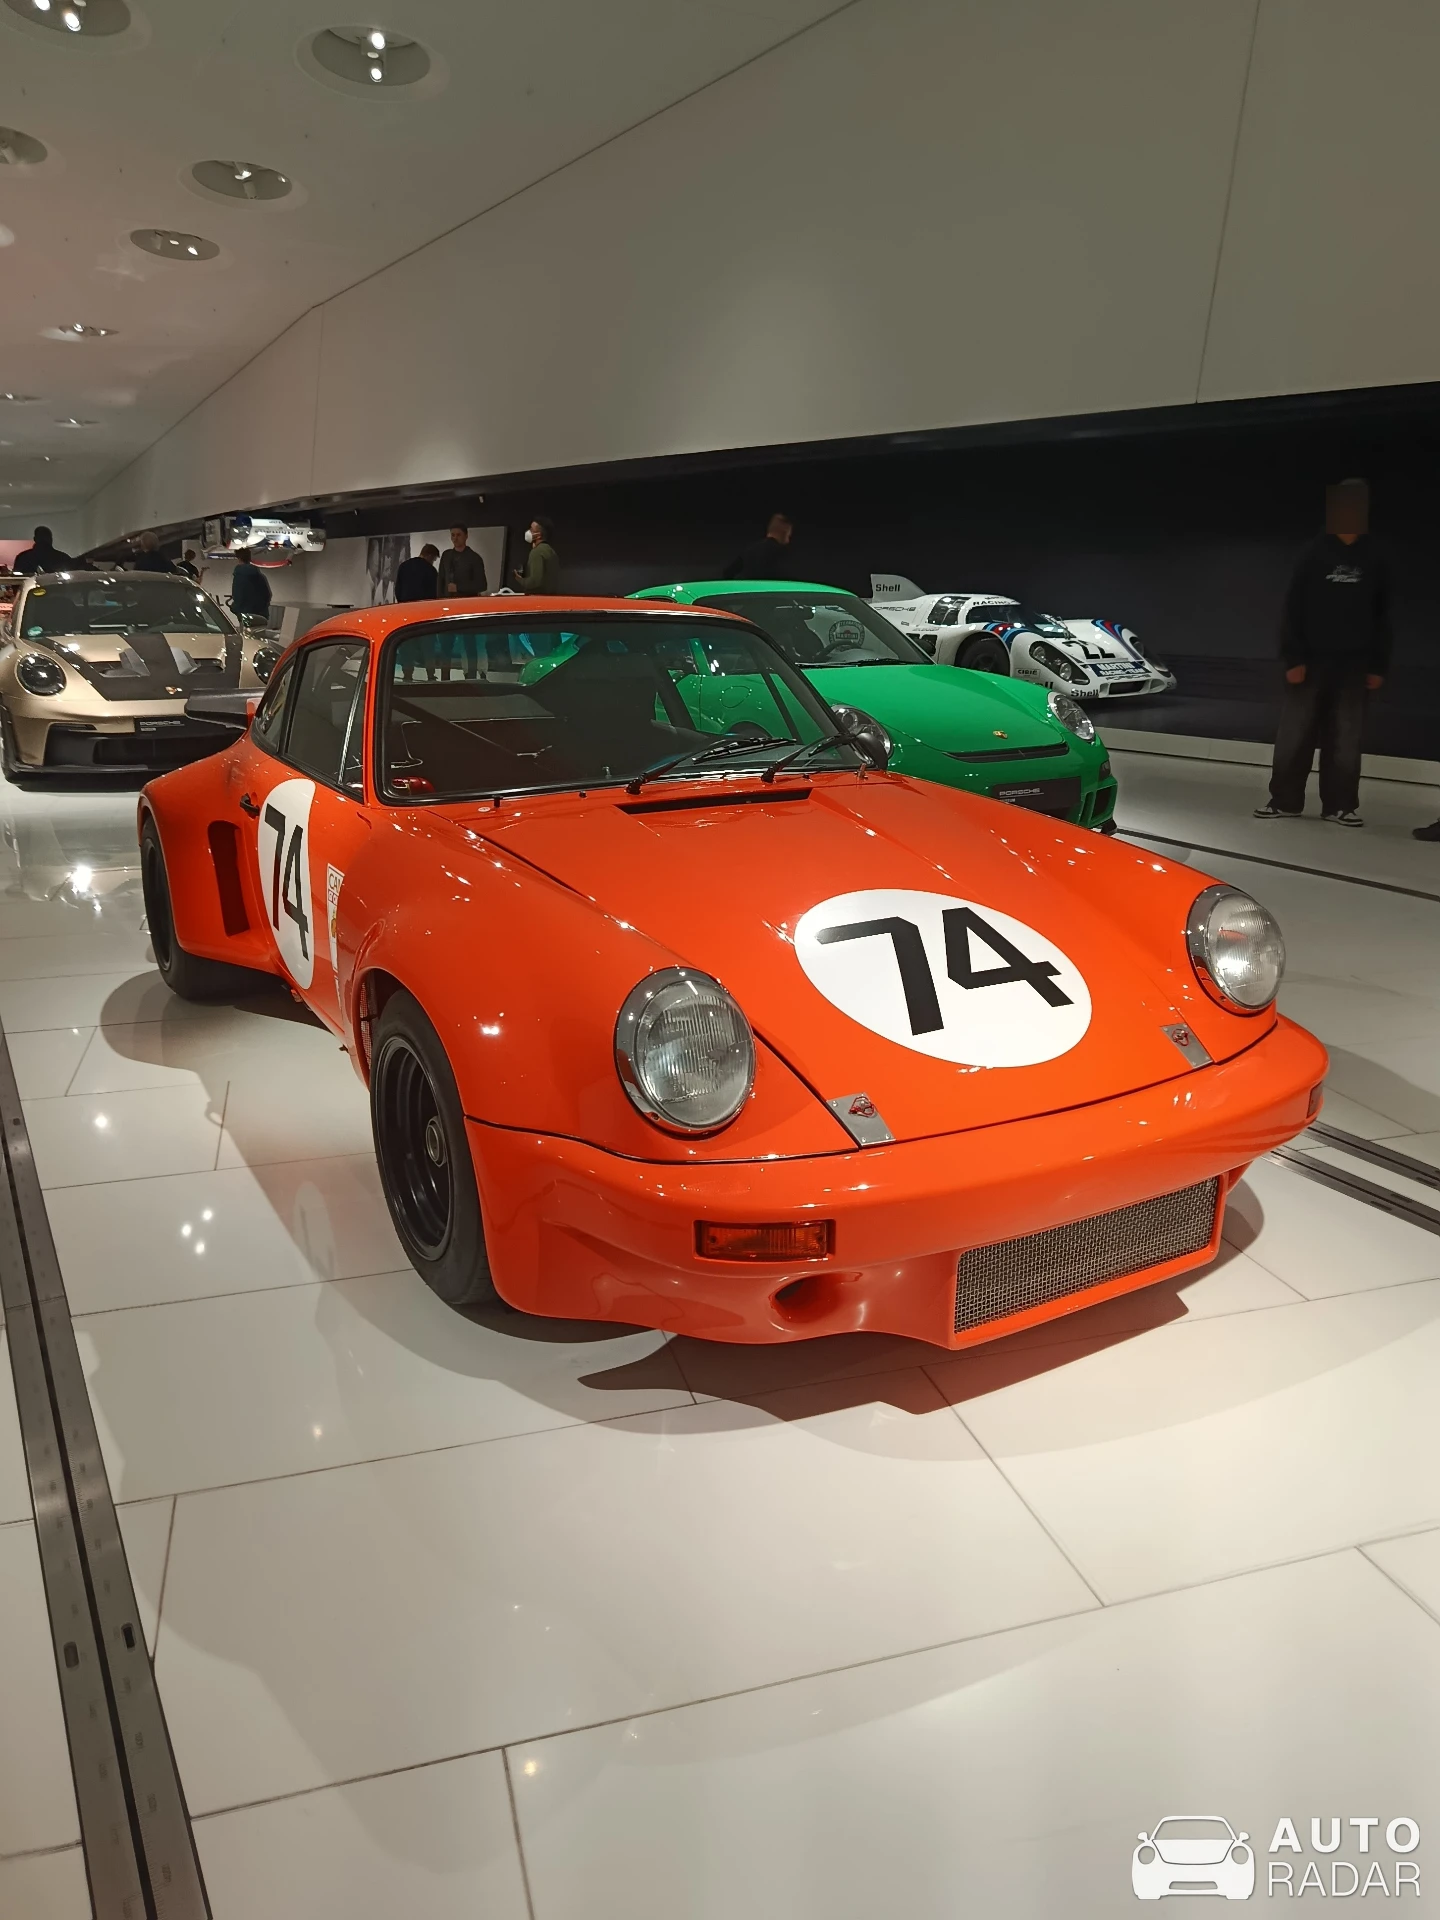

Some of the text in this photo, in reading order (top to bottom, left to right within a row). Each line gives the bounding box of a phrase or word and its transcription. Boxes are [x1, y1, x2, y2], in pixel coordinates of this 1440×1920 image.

[875, 583, 900, 592] Shell
[1061, 639, 1116, 660] 22
[1096, 662, 1136, 670] MARTINI
[1070, 689, 1100, 697] Shell
[999, 787, 1041, 796] PORSCHE
[264, 803, 310, 962] 74
[814, 906, 1075, 1036] 74
